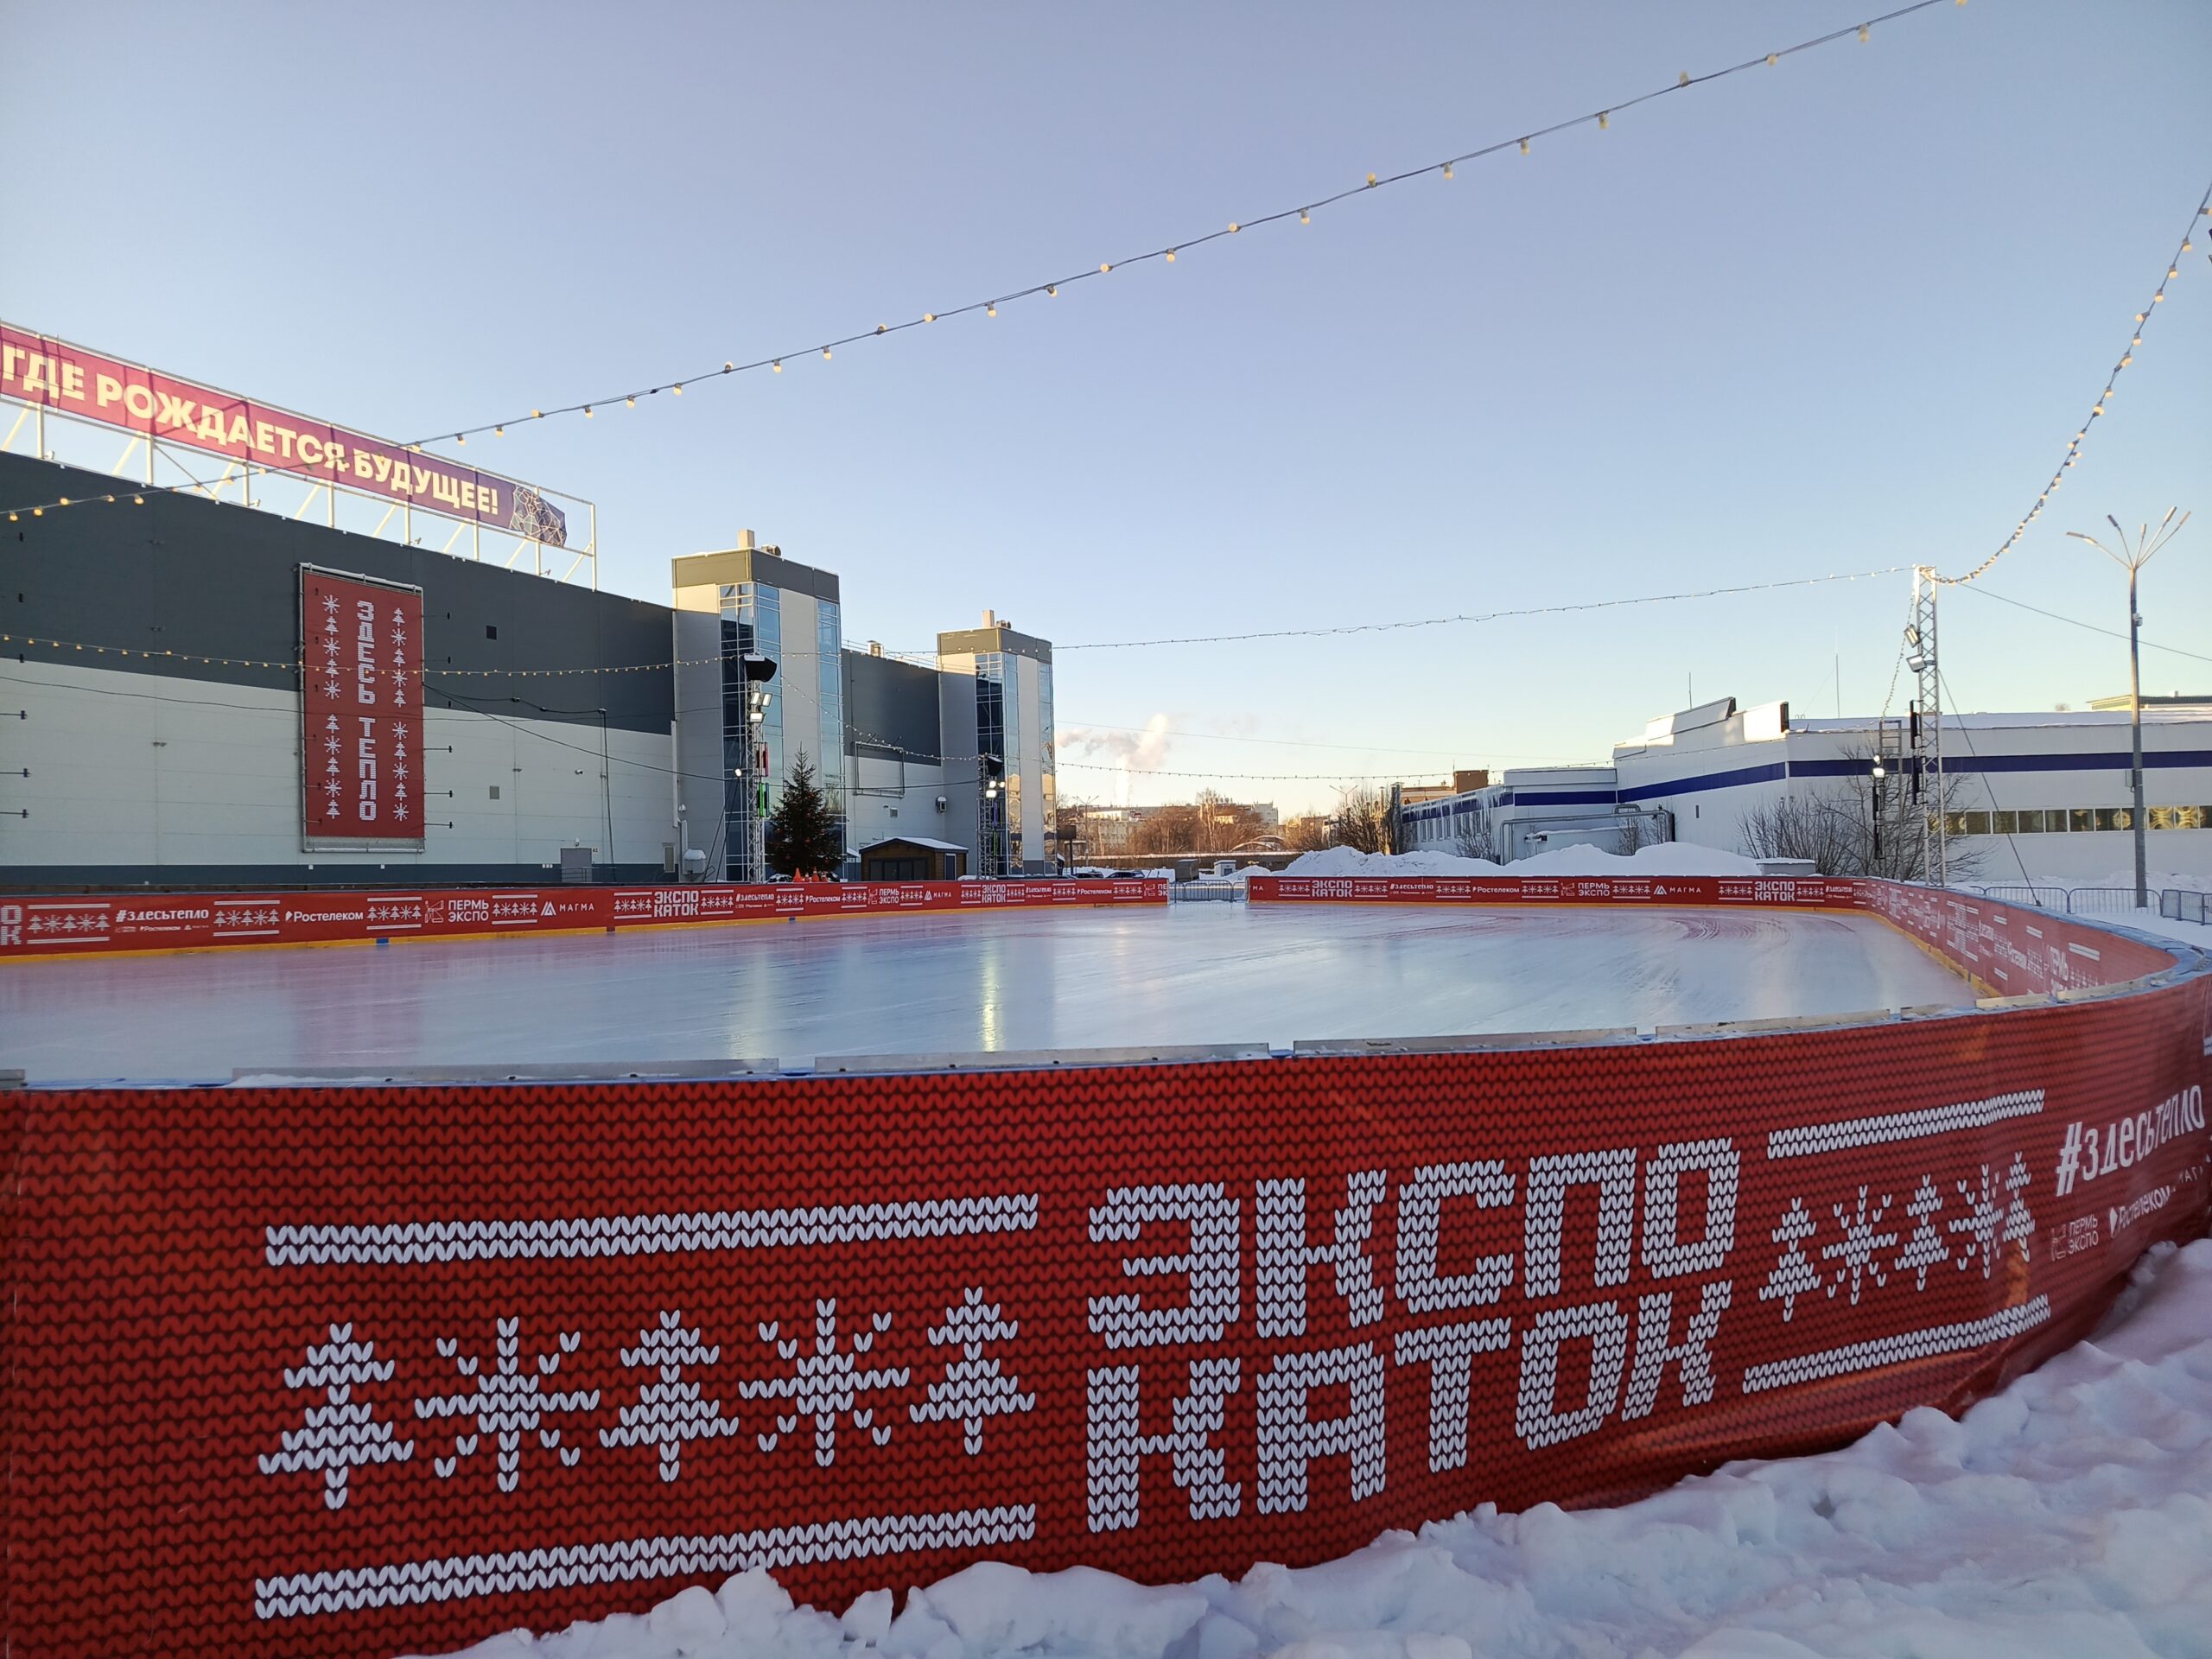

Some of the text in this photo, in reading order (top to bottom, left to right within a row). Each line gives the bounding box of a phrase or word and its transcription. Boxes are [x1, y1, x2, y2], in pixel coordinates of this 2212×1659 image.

[3, 345, 499, 515] ГДЕ РОЖДАЕТСЯ БУДУЩЕЕ!
[357, 601, 377, 821] ЗДЕСЬ ТЕПЛО
[982, 884, 1006, 893] ЭКСПО
[1312, 880, 1353, 889] ЭКСПО
[1477, 886, 1520, 894] Ростелеком
[1669, 886, 1702, 894] МАГМА
[1755, 880, 1796, 892] ЭКСПО
[654, 890, 699, 904] ЭКСПО
[809, 894, 841, 904] Ростелеком
[982, 893, 1006, 904] КАТОК
[1312, 888, 1353, 898] КАТОК
[1755, 891, 1796, 902] КАТОК
[448, 899, 490, 911] ПЕРМЬ
[879, 896, 899, 905] ЭКСПО
[559, 902, 595, 913] МАГМА
[654, 903, 699, 918] КАТОК
[116, 909, 209, 922] #здесьтепло
[294, 910, 364, 923] Ростелеком
[448, 910, 490, 923] ЭКСПО
[2069, 1213, 2099, 1237] ПЕРМЬ
[1089, 1136, 1740, 1349] ЭКСПО
[2068, 1230, 2100, 1255] ЭКСПО
[1087, 1280, 1732, 1533] КАТОК
